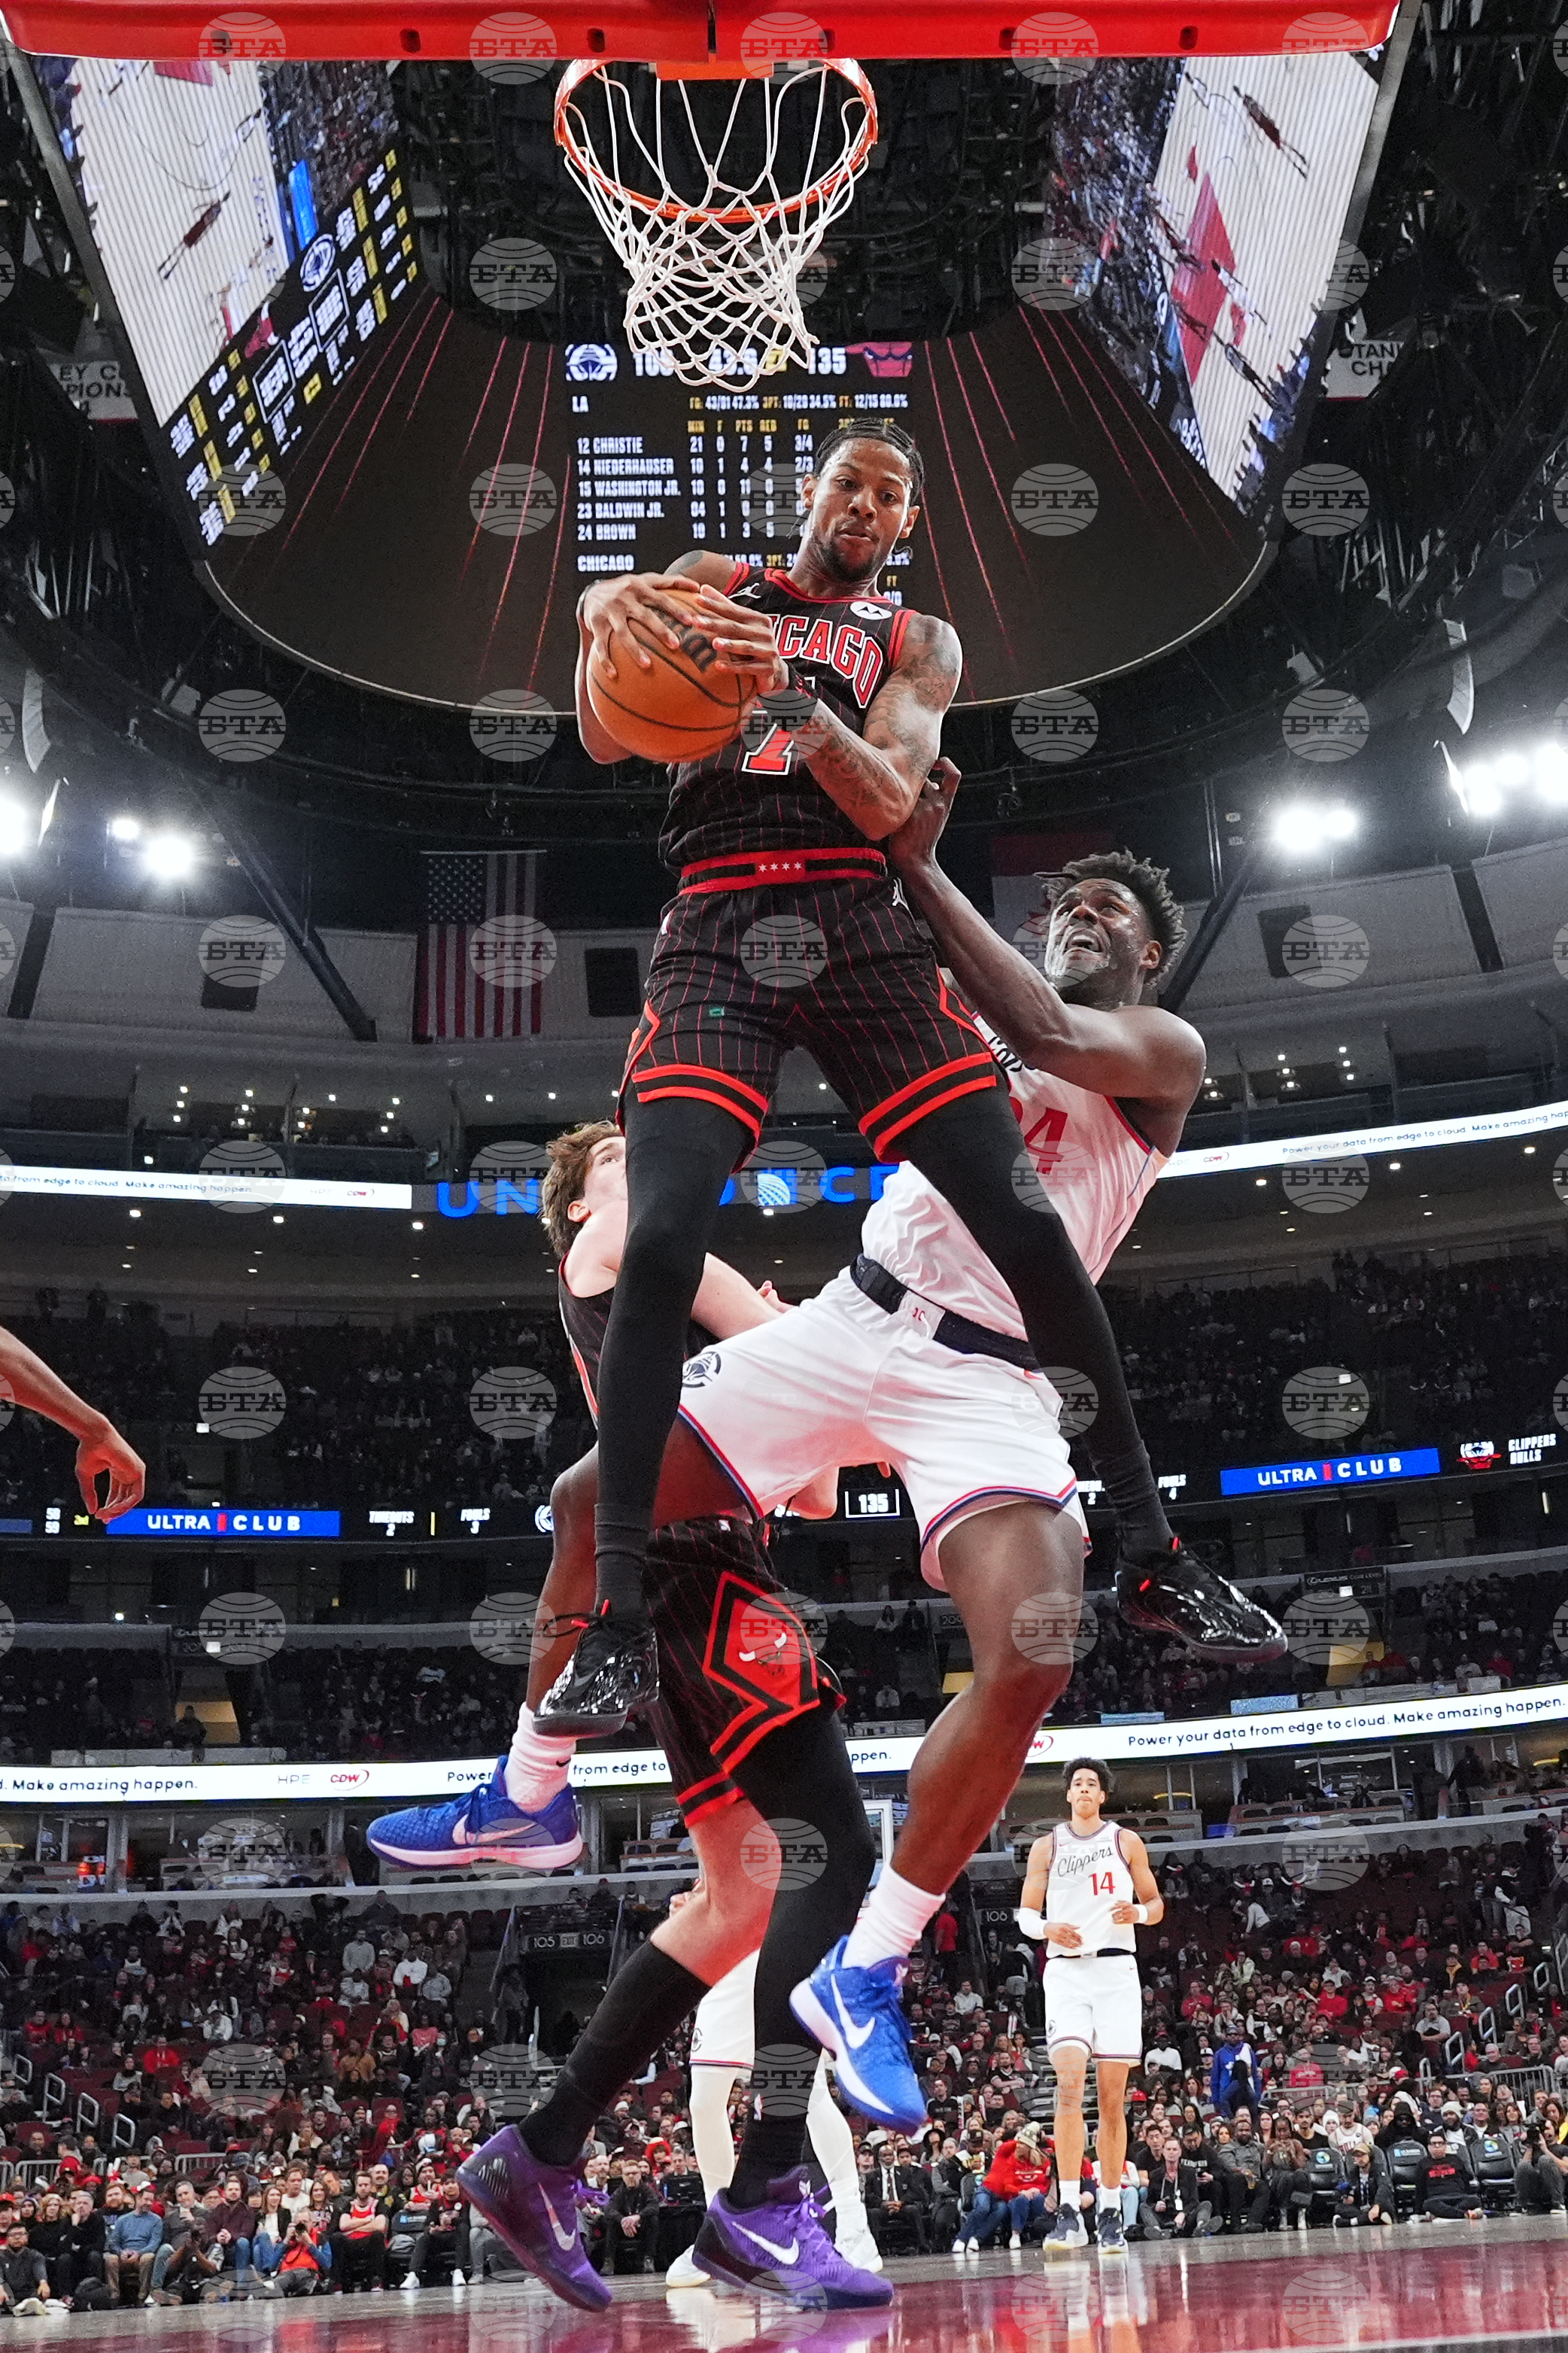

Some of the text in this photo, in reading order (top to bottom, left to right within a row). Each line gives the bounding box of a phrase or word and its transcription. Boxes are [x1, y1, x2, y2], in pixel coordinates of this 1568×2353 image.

[808, 347, 846, 375] 135
[572, 395, 588, 412] LA
[577, 437, 591, 454] 12
[593, 436, 643, 454] CHRISTIE
[690, 436, 703, 453] 21
[740, 435, 748, 452] 7
[795, 434, 813, 451] 3/4
[577, 459, 591, 476] 14
[717, 458, 724, 474] 1
[740, 457, 749, 473] 4
[579, 481, 591, 497] 15
[594, 480, 662, 497] WASHINGTON
[577, 503, 592, 519] 23
[595, 502, 645, 518] BALDWIN
[719, 500, 725, 517] 1
[577, 524, 592, 540] 24
[596, 524, 636, 540] BROWN
[719, 522, 726, 539] 1
[577, 555, 634, 572] CHICAGO
[767, 613, 884, 709] CAGO
[1009, 1096, 1068, 1175] 4
[1282, 1145, 1313, 1154] Power
[1317, 1143, 1339, 1152] your
[1342, 1138, 1366, 1147] data
[1369, 1135, 1393, 1144] from
[1396, 1132, 1421, 1142] edge
[1472, 1123, 1500, 1132] Make
[1503, 1114, 1548, 1129] amazing
[1551, 1111, 1568, 1123] hap
[14, 1175, 41, 1184] from
[44, 1177, 71, 1187] edge
[125, 1181, 155, 1190] Make
[158, 1181, 206, 1193] amazing
[1509, 1433, 1556, 1452] CLIPPERS
[1509, 1449, 1542, 1465] BULLS
[1257, 1457, 1402, 1487] ULTRA CLUB
[1158, 1474, 1187, 1489] FOULS
[1087, 1492, 1096, 1505] 2
[1168, 1487, 1178, 1500] 4
[858, 1493, 889, 1513] 135
[369, 1510, 415, 1524] TIMEOUTS
[460, 1507, 491, 1522] FOULS
[147, 1515, 301, 1532] ULTRA CLUB
[386, 1523, 396, 1537] 2
[470, 1521, 480, 1534] 3
[1129, 1698, 1566, 1747] Power your data from edge to cloud. Make amazing happen.
[851, 1750, 892, 1766] ppen.
[573, 1760, 667, 1776] from edge to
[278, 1773, 360, 1785] HPE CDW
[447, 1771, 492, 1783] Power
[13, 1779, 54, 1790] Make
[59, 1778, 129, 1795] amazing
[134, 1778, 198, 1793] happen.
[1058, 1846, 1114, 1877] Clippers
[1088, 1871, 1116, 1895] 14
[986, 1910, 1007, 1923] 106
[533, 1936, 555, 1948] 105
[582, 1933, 605, 1945] 106
